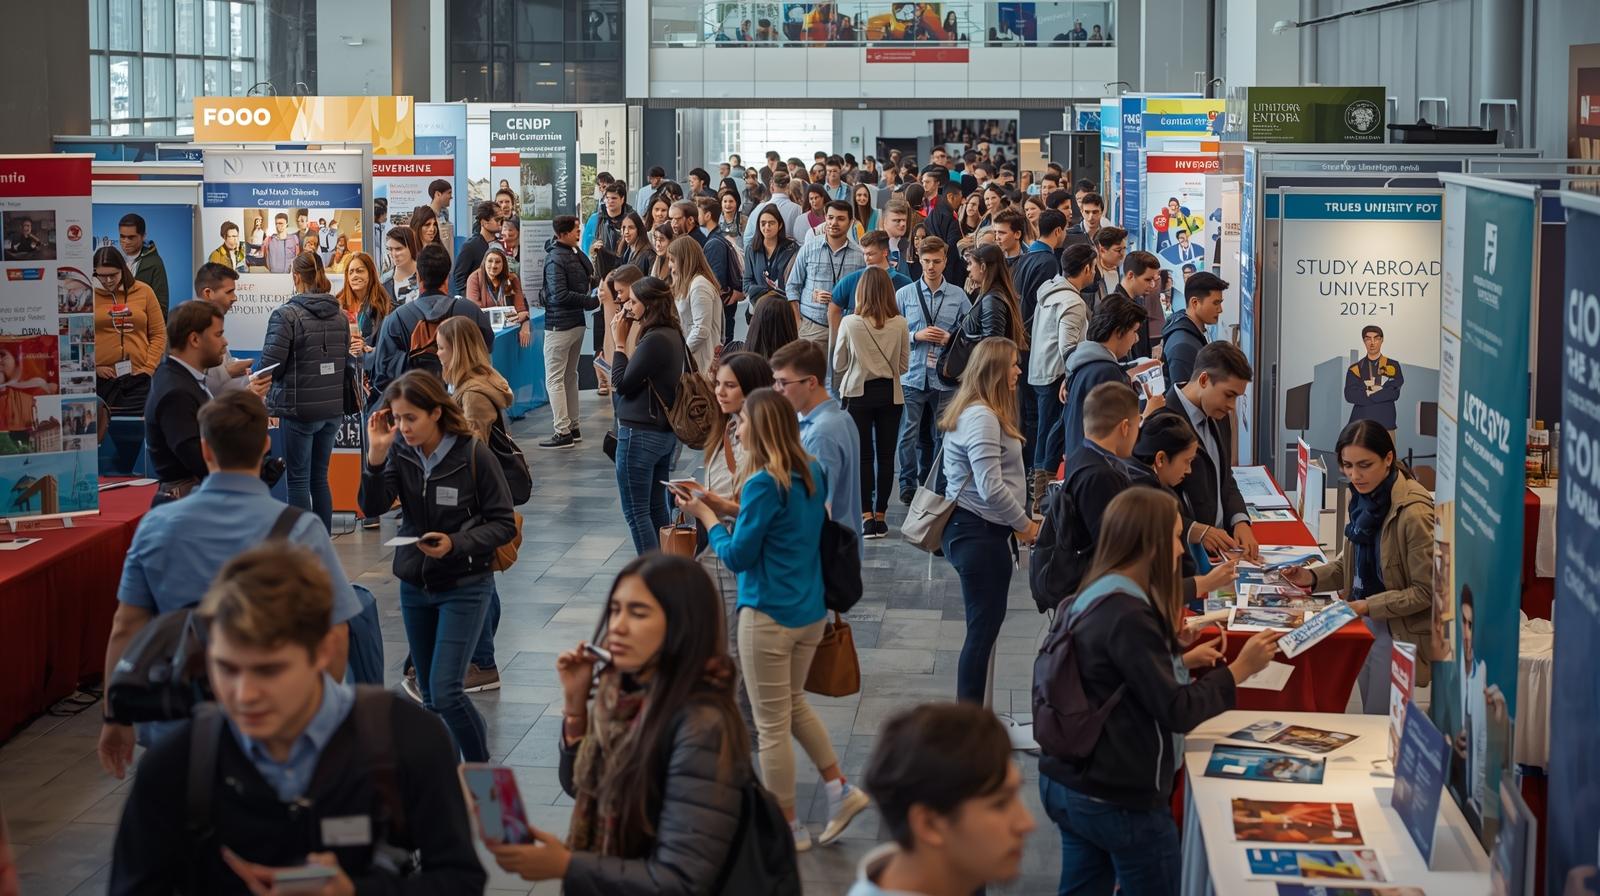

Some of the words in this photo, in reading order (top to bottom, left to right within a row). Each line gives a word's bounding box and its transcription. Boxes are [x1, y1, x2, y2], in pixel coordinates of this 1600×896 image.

[203, 107, 271, 126] FOOO
[506, 118, 551, 130] CENDP
[1296, 259, 1359, 276] STUDY
[1362, 260, 1441, 277] ABROAD
[1319, 281, 1429, 298] UNIVERSITY
